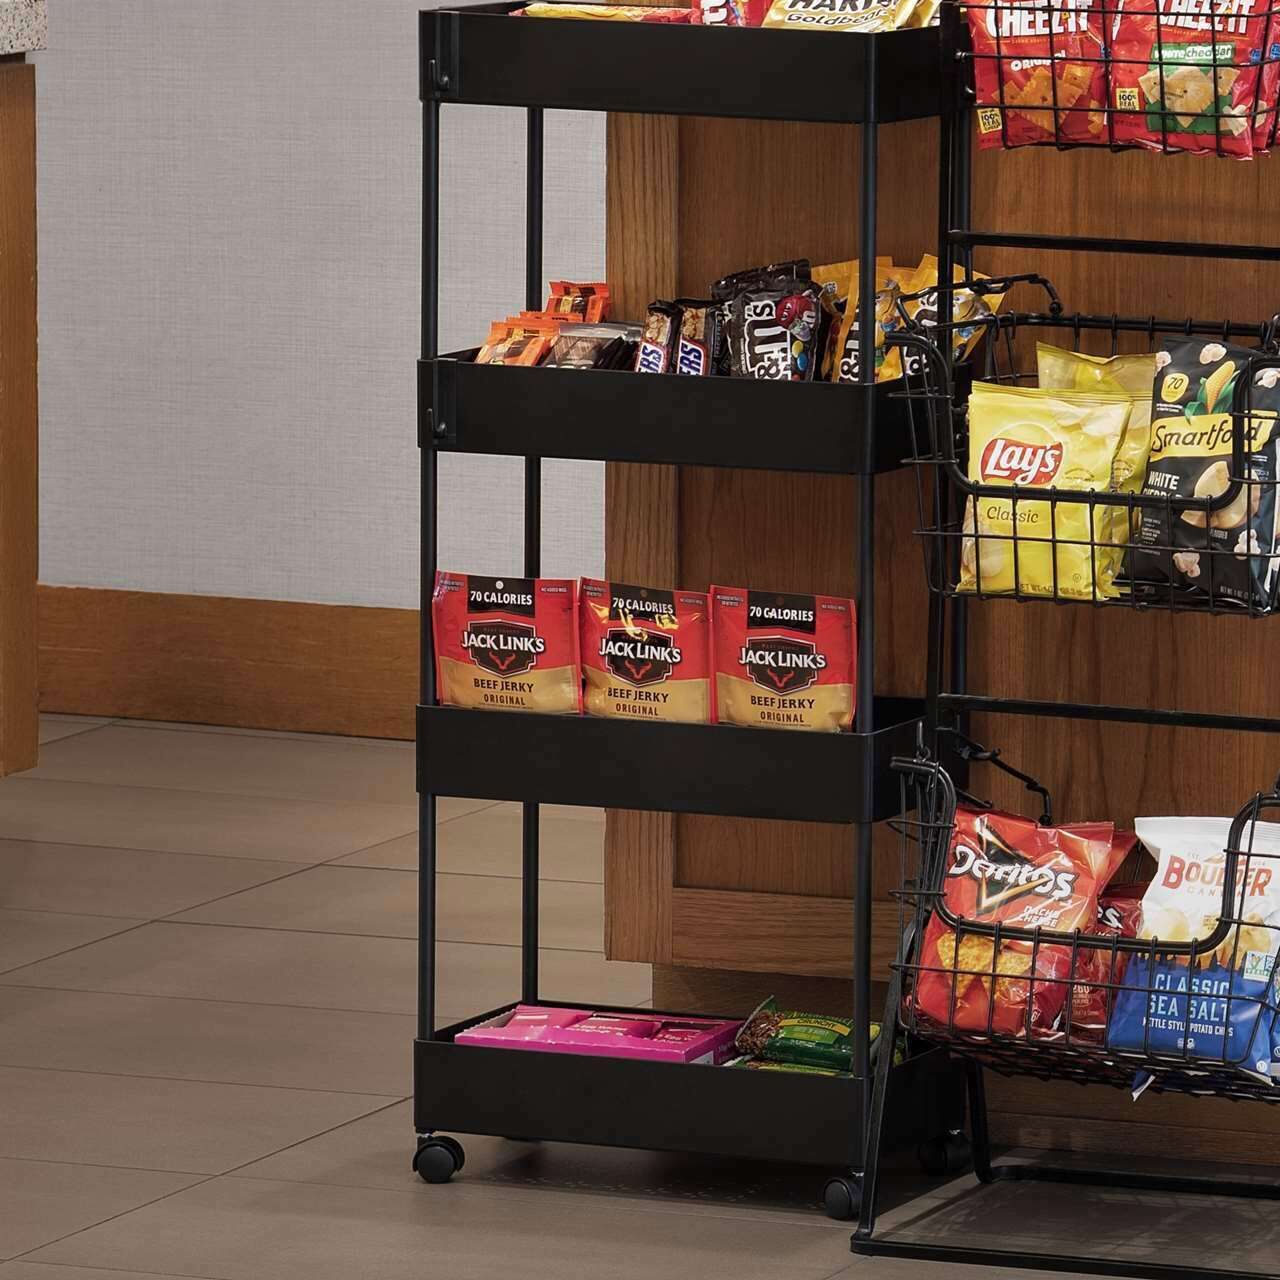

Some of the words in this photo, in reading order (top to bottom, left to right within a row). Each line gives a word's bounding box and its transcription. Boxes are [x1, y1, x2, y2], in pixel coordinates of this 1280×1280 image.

[1167, 376, 1184, 389] 70
[1151, 419, 1261, 452] Smartfod
[984, 439, 1061, 485] Lay's
[1147, 471, 1180, 490] WHITE
[470, 591, 482, 601] 70
[484, 591, 533, 606] CALORIES
[612, 597, 624, 608] 70
[626, 598, 674, 614] CALORIES
[750, 606, 762, 617] 70
[763, 607, 814, 622] CALORIES
[462, 631, 498, 650] JACK
[500, 634, 545, 653] LINK'S
[599, 638, 635, 659] JACK
[636, 642, 681, 663] LINK'S
[739, 647, 777, 667] JACK
[778, 650, 826, 669] LINK'S
[474, 678, 498, 689] BEEF
[500, 681, 534, 693] JERKY
[483, 694, 526, 706] ORIGINAL
[608, 687, 632, 699] BEEF
[634, 690, 669, 703] JERKY
[751, 696, 776, 707] BEEF
[777, 698, 815, 709] JERKY
[615, 703, 659, 716] ORIGINAL
[760, 711, 804, 723] ORIGINAL
[949, 844, 1075, 898] Doritos
[1149, 994, 1179, 1017] SEA
[1189, 999, 1229, 1022] SALT
[1189, 1022, 1213, 1034] POTATO
